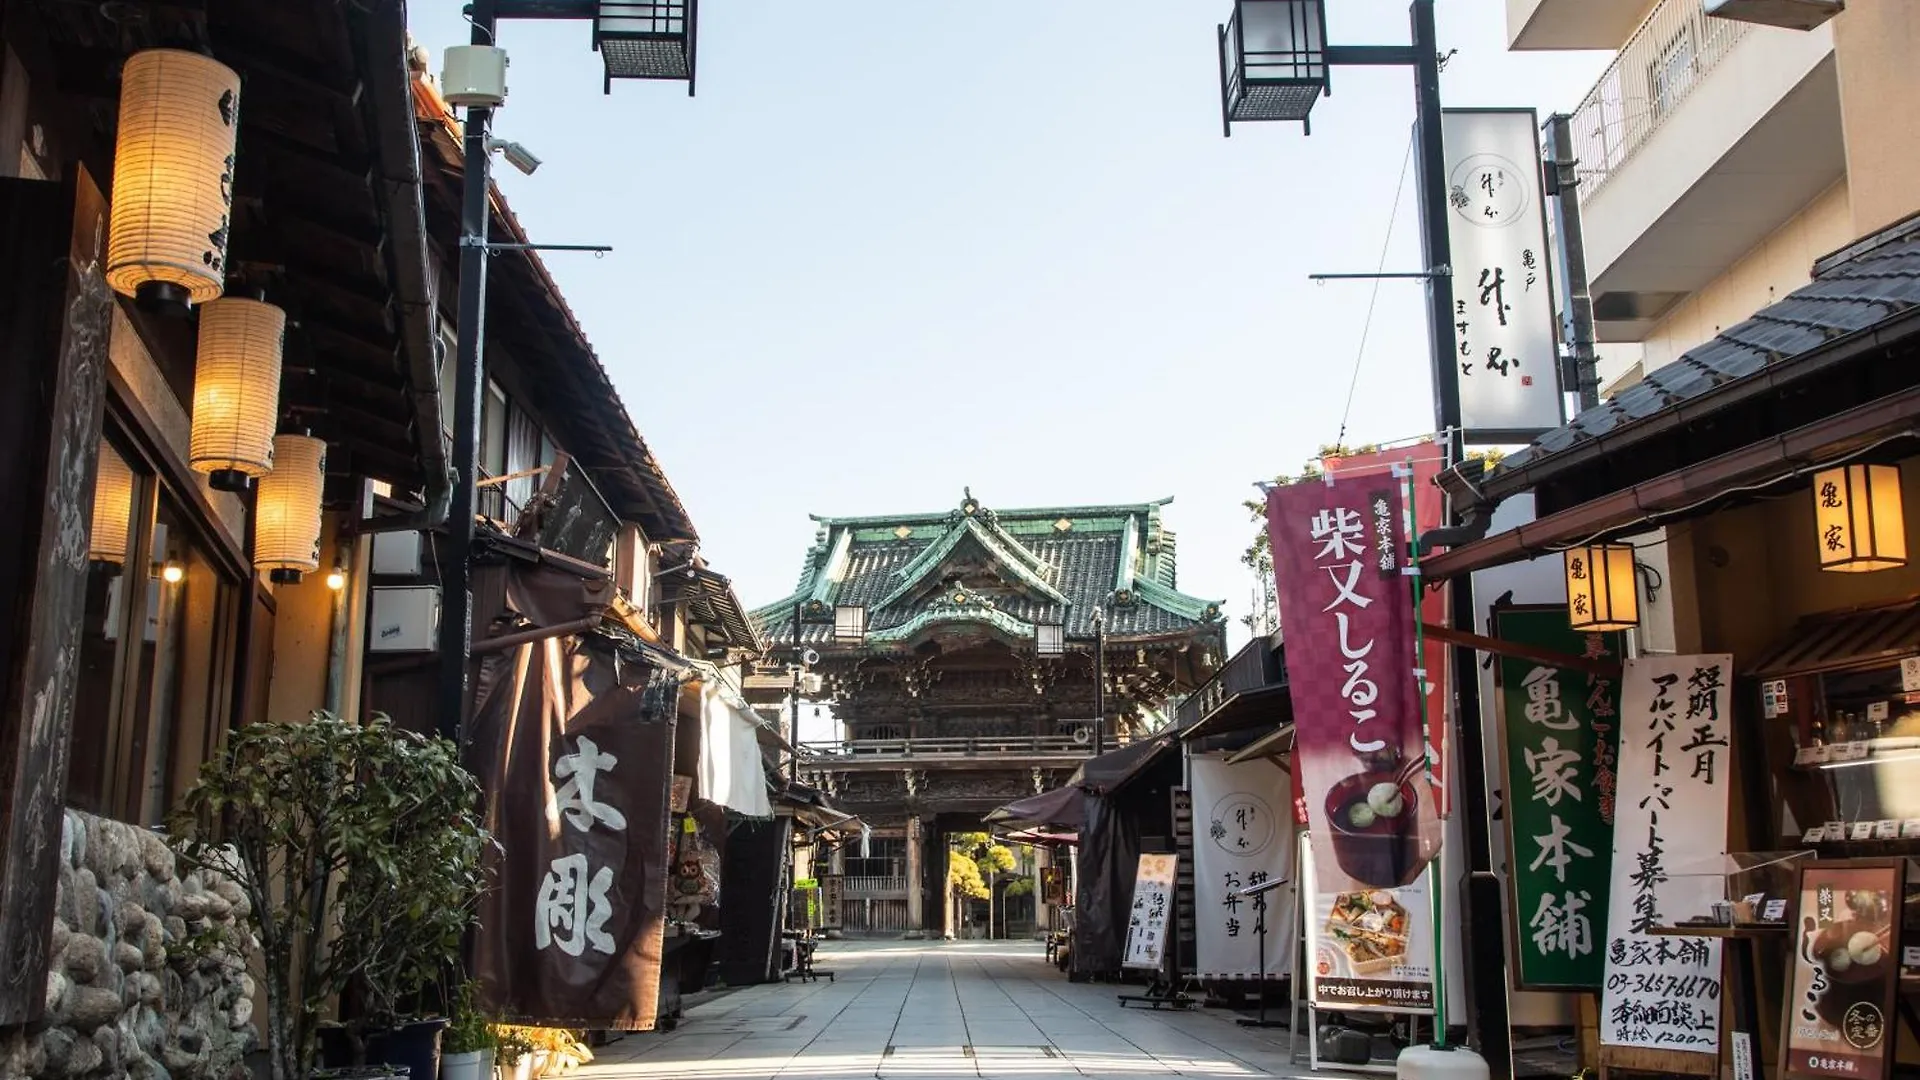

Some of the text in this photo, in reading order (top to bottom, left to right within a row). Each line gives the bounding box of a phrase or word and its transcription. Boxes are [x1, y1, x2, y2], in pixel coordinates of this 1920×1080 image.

[1522, 249, 1536, 292] 亀戸
[1456, 299, 1473, 376] ますもと
[1374, 499, 1394, 570] 亀家本舗
[1821, 482, 1845, 551] 亀家
[1310, 507, 1386, 753] 柴又しるこ
[1680, 665, 1729, 784] 短期正月
[535, 735, 628, 957] 木彫
[1521, 666, 1594, 960] 亀家本舗
[1222, 871, 1243, 938] お弁当
[1318, 985, 1430, 1000] 中でお召し上がり頂けます
